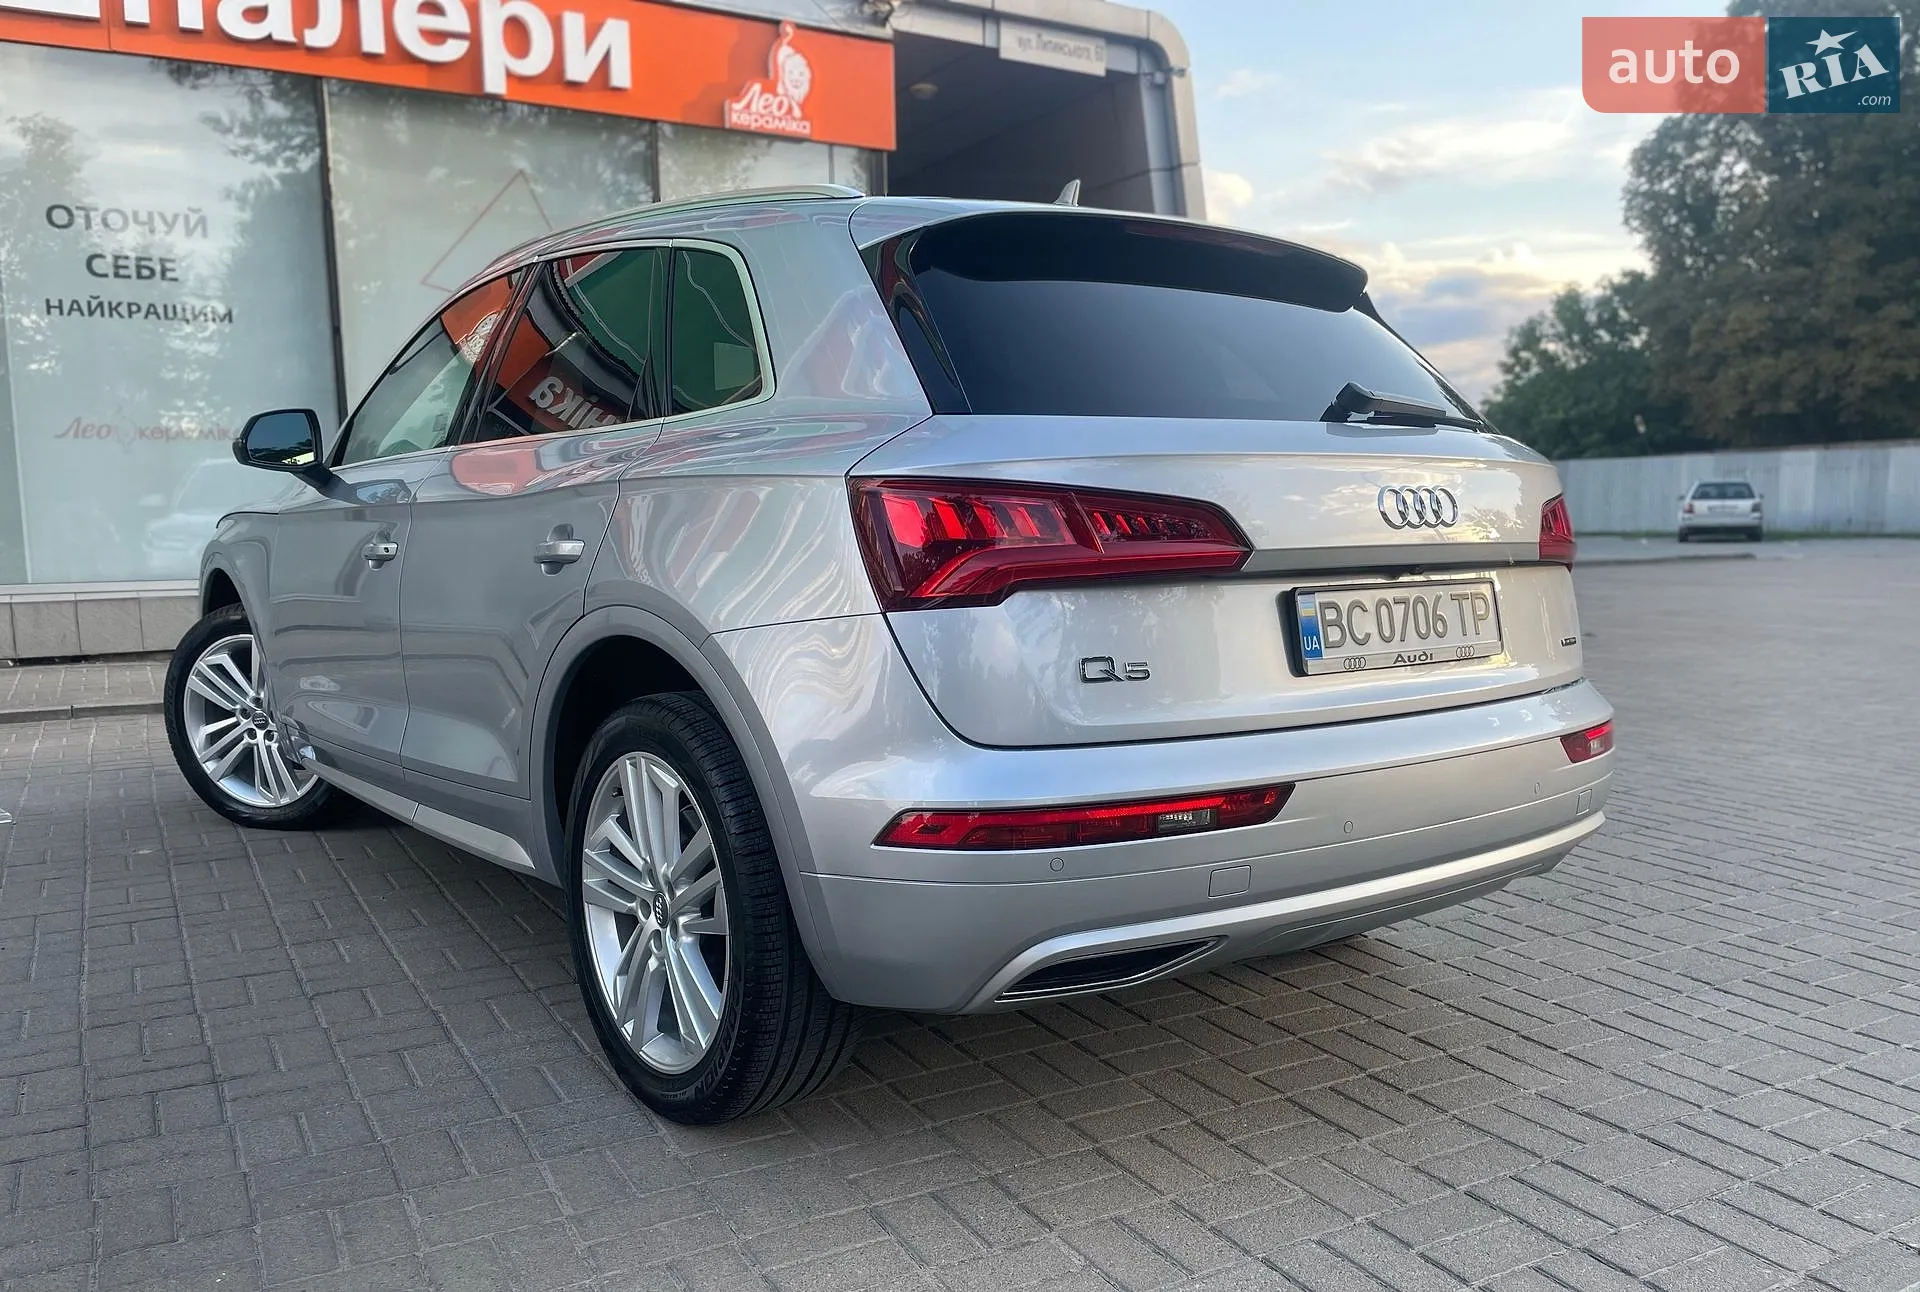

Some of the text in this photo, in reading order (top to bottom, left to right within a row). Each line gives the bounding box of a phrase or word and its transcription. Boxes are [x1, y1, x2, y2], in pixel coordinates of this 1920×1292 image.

[731, 82, 789, 117] Лео
[731, 111, 812, 135] кераміка
[45, 204, 208, 239] ОТОЧУЙ
[85, 253, 179, 282] СЕБЕ
[45, 295, 234, 325] НАЙКРАЩИМ
[53, 417, 112, 440] Лео
[1304, 590, 1490, 650] UA BC 0706 TP
[1079, 655, 1151, 684] Q5
[1392, 651, 1434, 665] Audi
